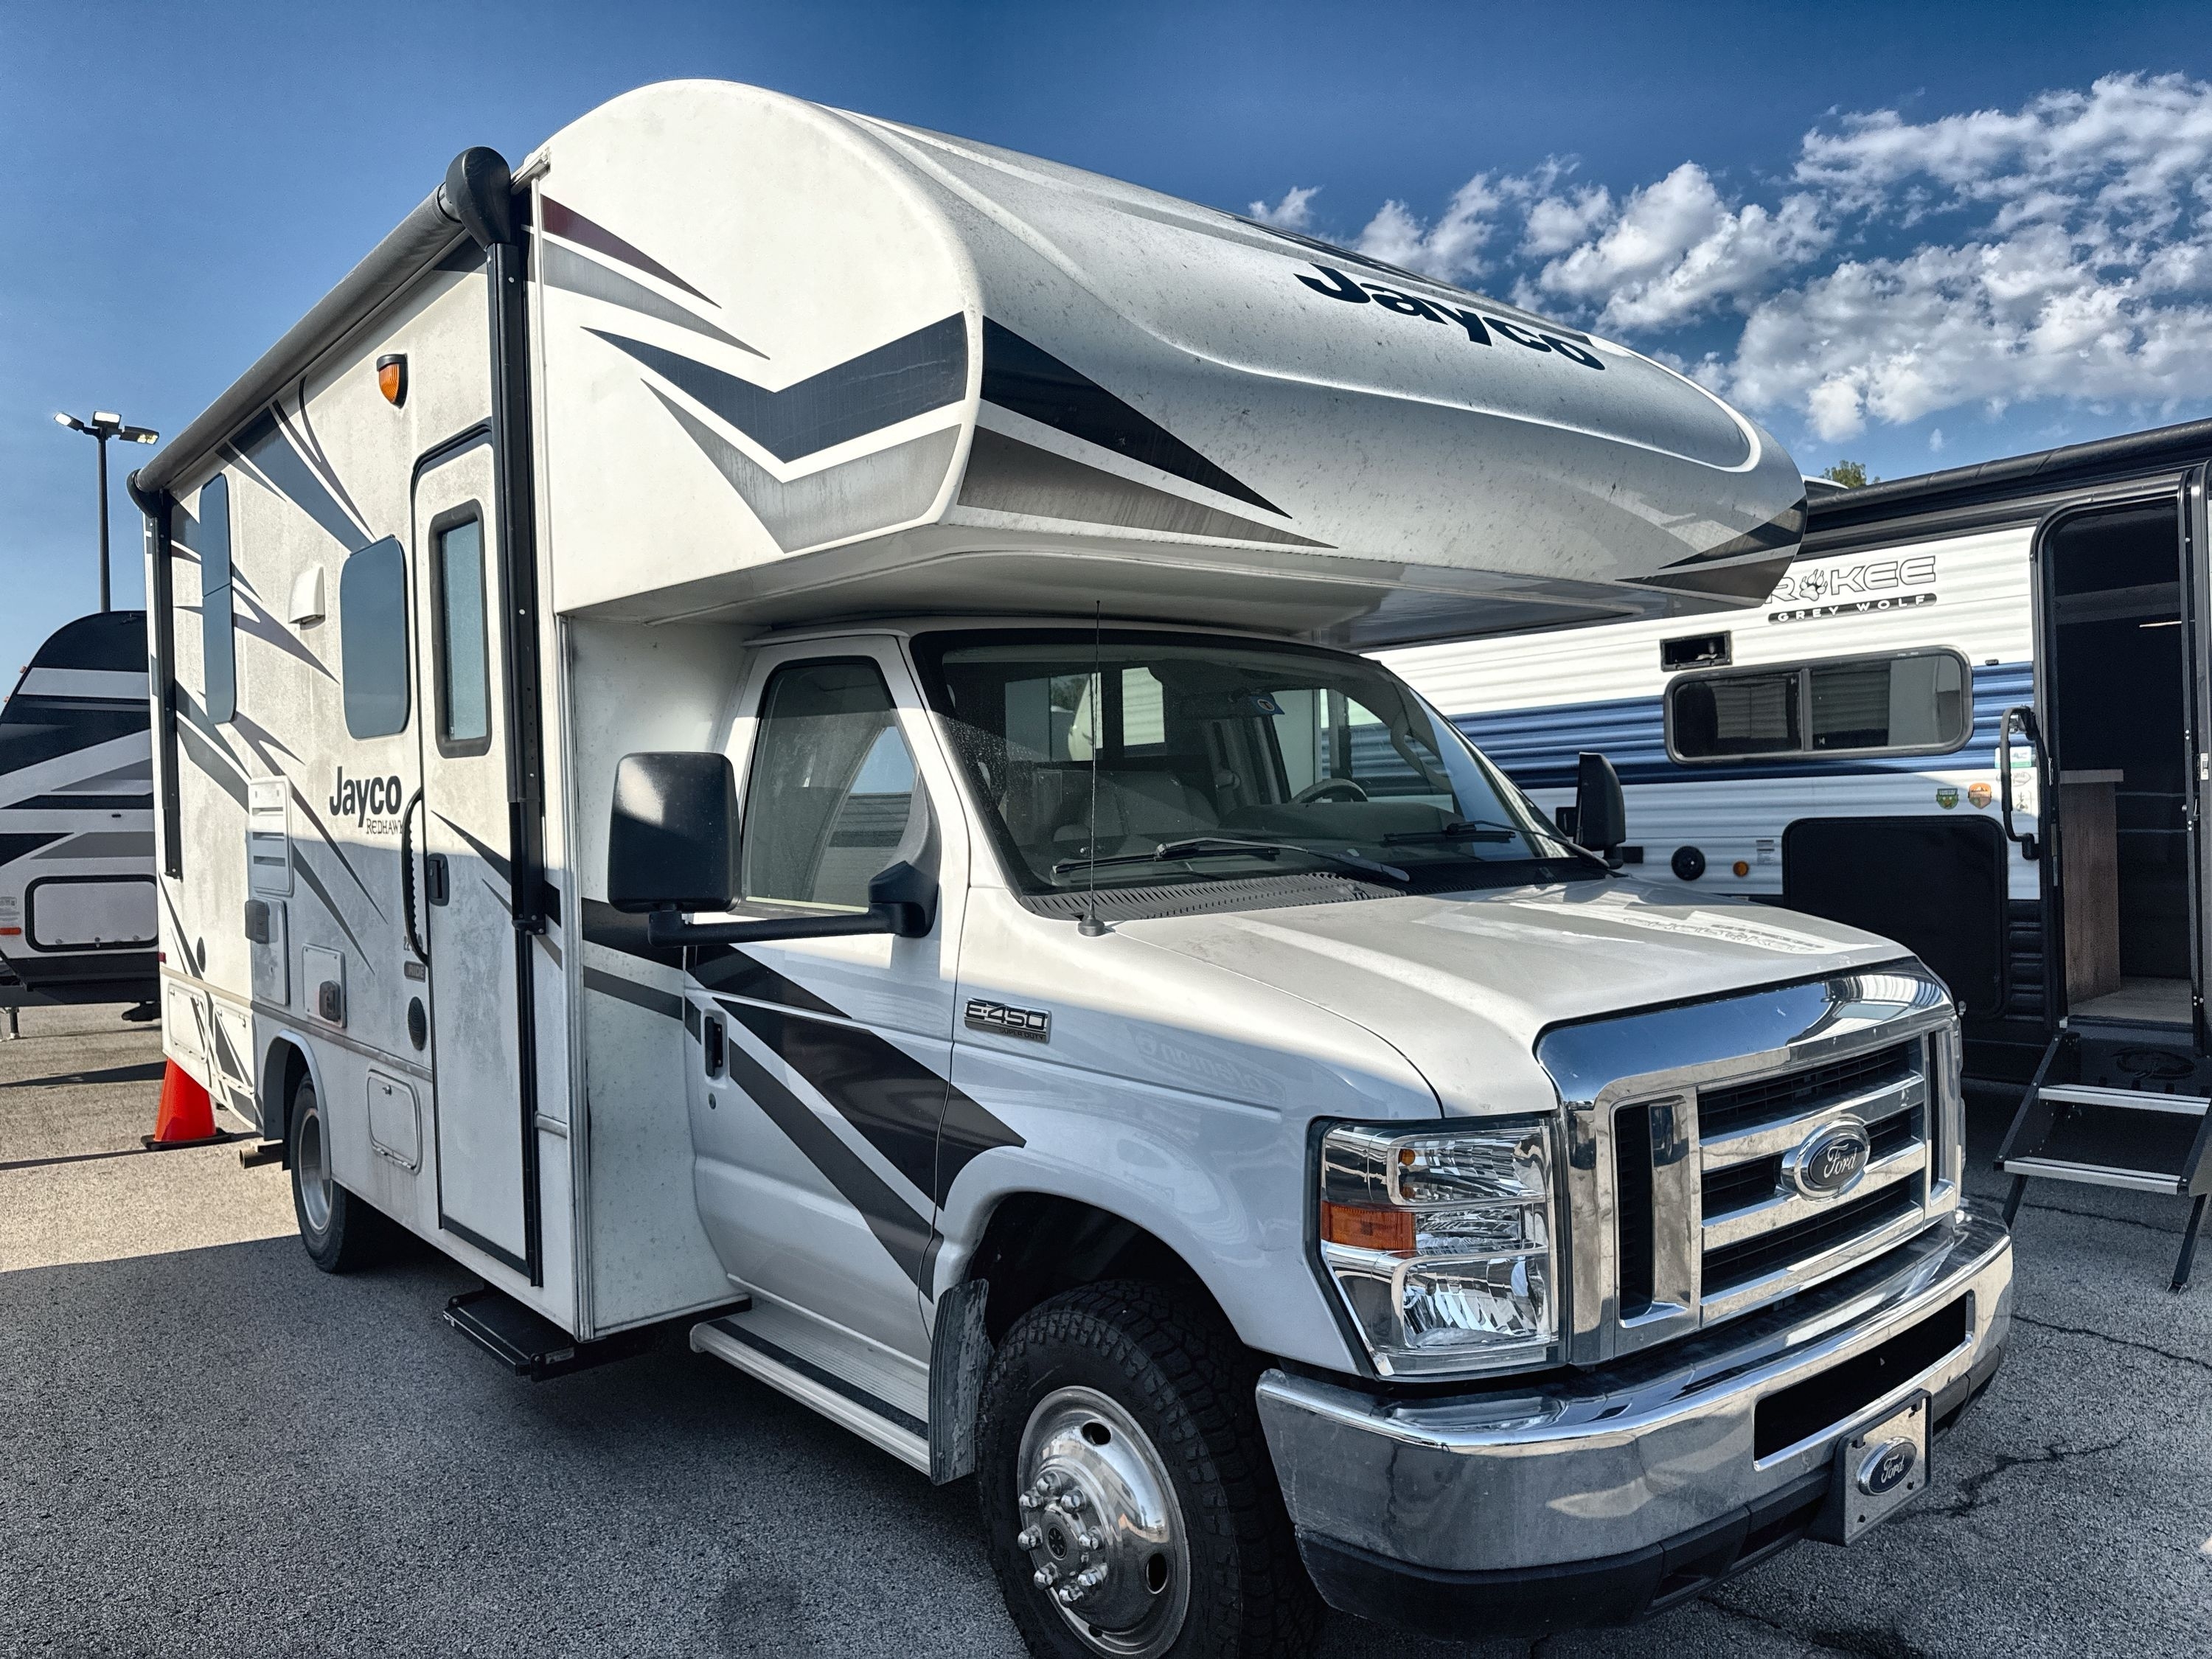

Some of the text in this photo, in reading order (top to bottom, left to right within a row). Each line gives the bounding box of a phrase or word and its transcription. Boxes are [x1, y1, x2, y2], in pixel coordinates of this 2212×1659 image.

[1293, 262, 1605, 370] Jayco
[1778, 595, 1925, 622] GREY WOLF
[330, 766, 402, 827] Jayco
[998, 1028, 1044, 1040] SUPER DUTY
[1823, 1144, 1857, 1178] Ford
[1881, 1454, 1905, 1484] Ford
